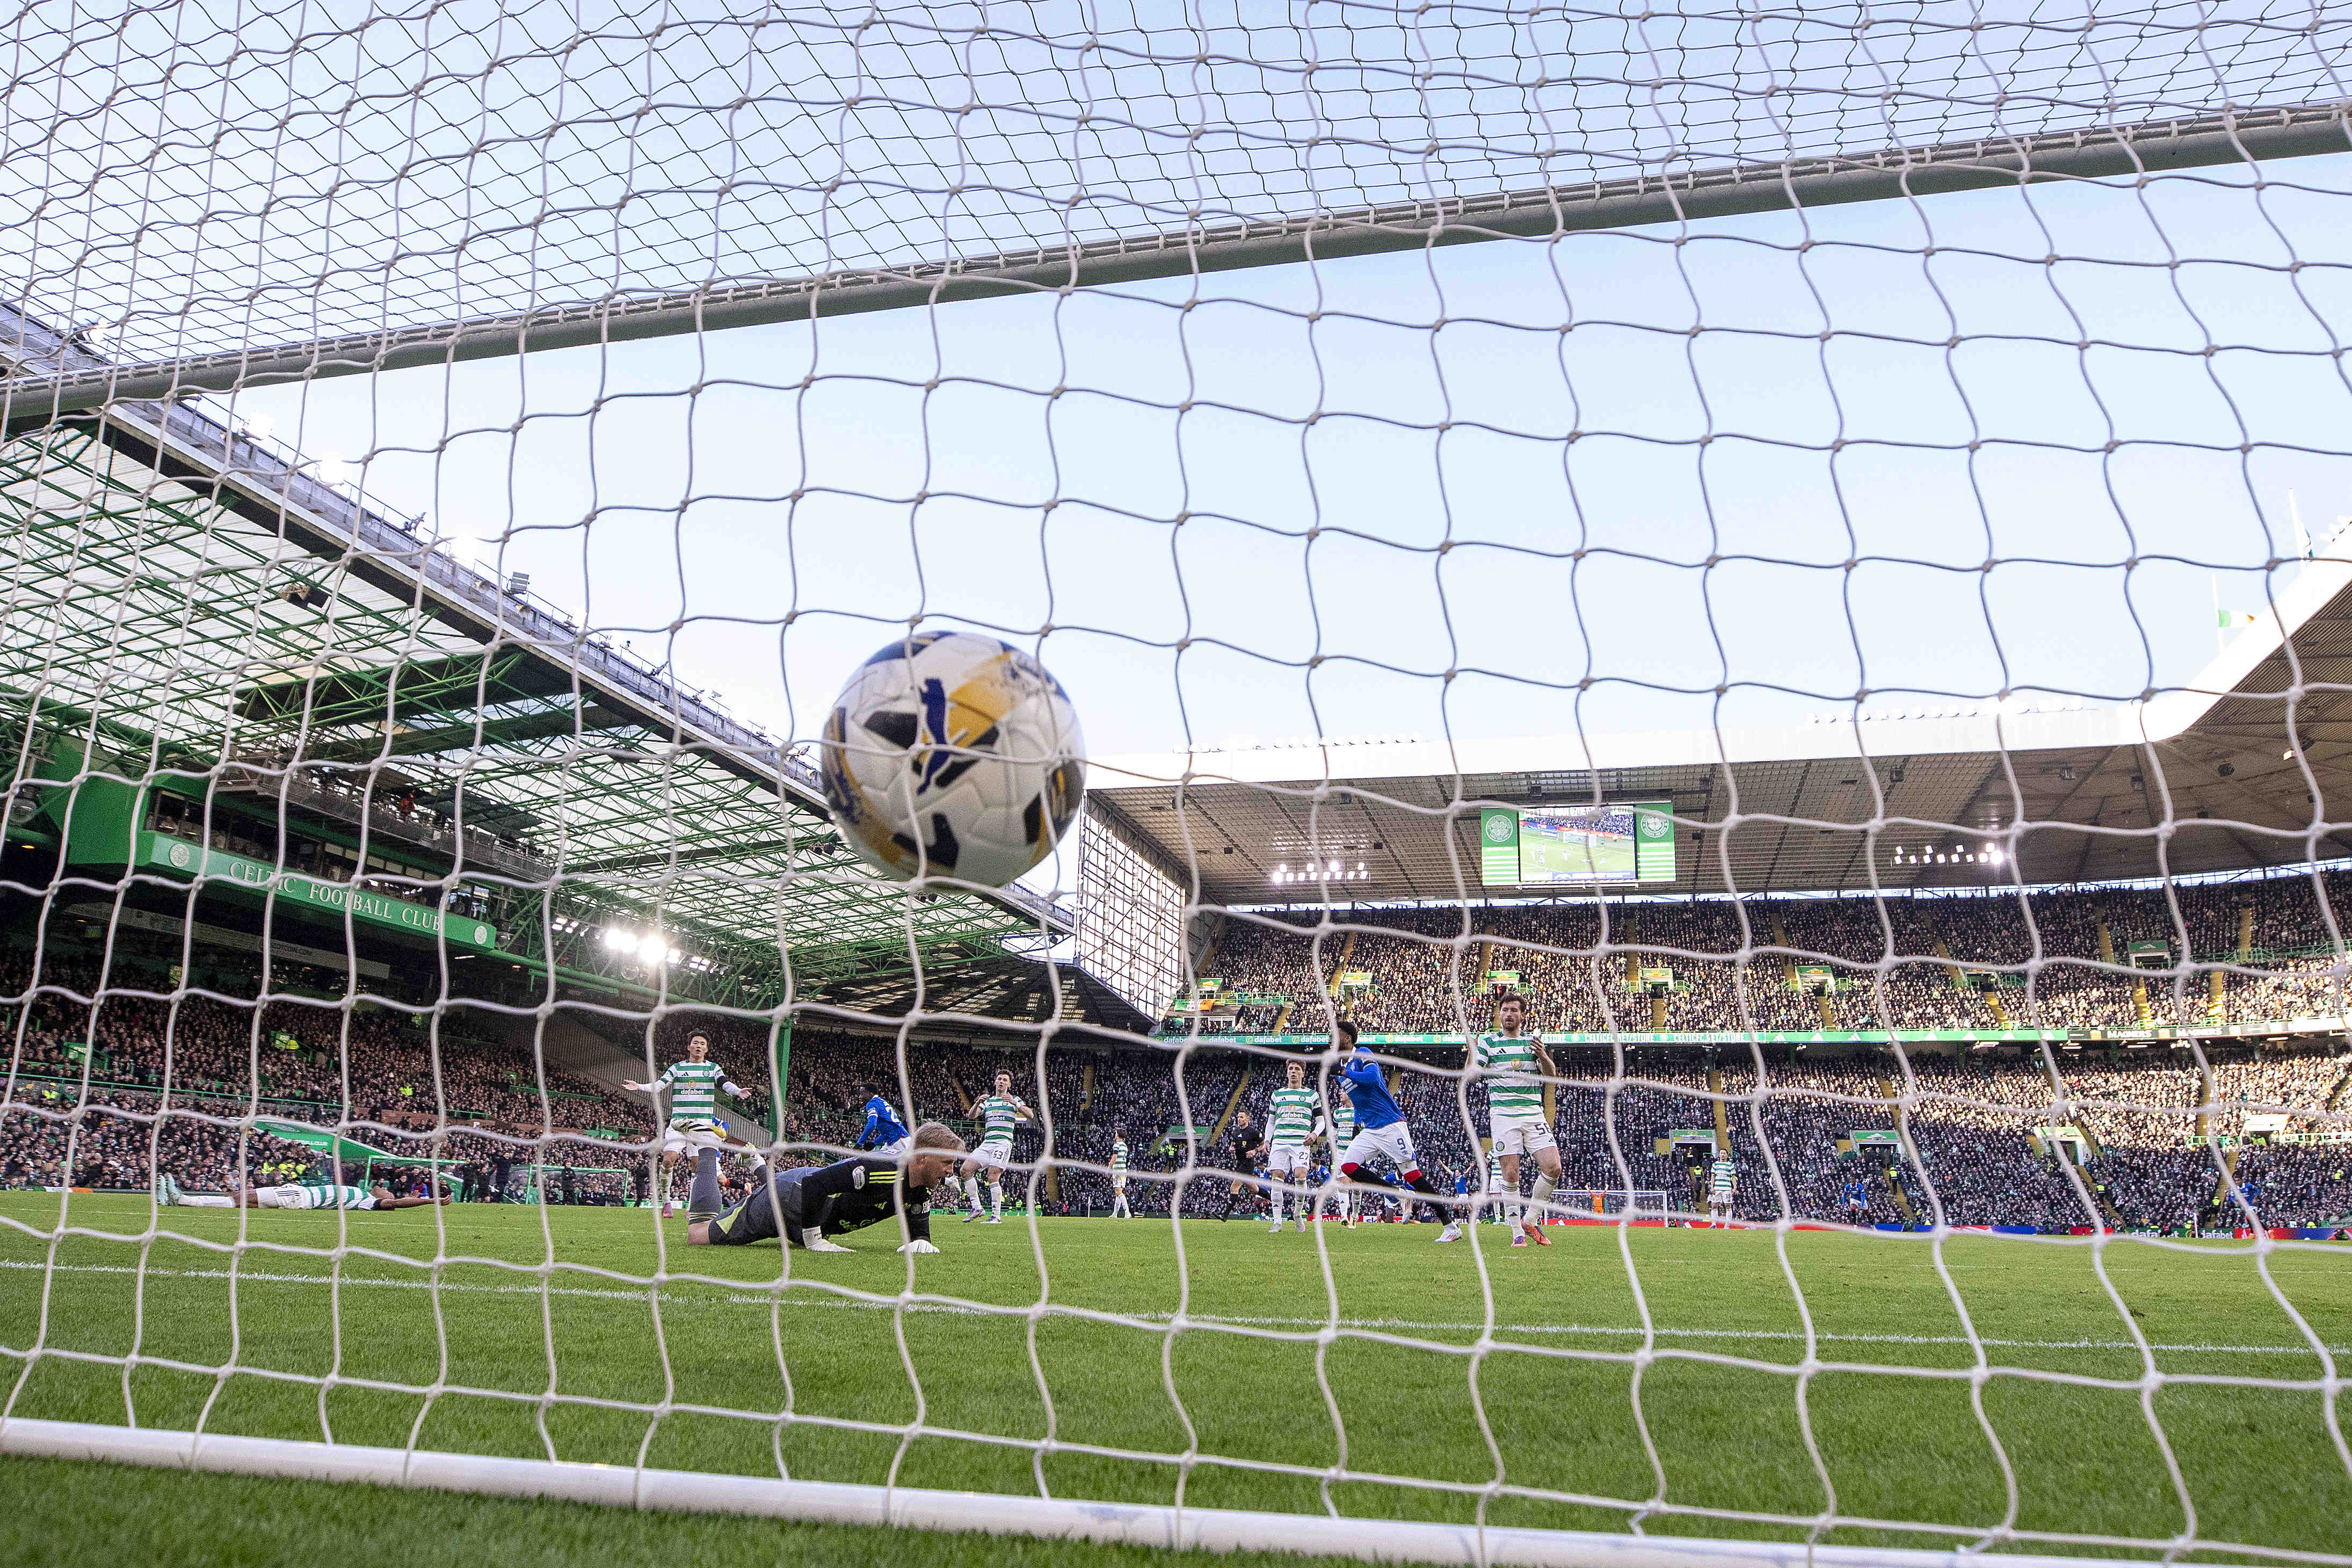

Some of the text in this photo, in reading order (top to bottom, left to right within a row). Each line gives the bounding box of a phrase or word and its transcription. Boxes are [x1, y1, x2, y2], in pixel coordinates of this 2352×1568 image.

[309, 883, 391, 918] FOOTBALL
[402, 908, 440, 931] CLUB
[1164, 1036, 1187, 1044] dafab
[1254, 1036, 1282, 1044] dafabet
[1301, 1035, 1329, 1043] dafabet
[1442, 1035, 1467, 1043] dafabe
[1585, 1034, 1654, 1042] CELTICFCNET/STORE
[1397, 1138, 1406, 1150] 9
[1299, 1151, 1309, 1160] 27
[2131, 1229, 2179, 1238] dafaet
